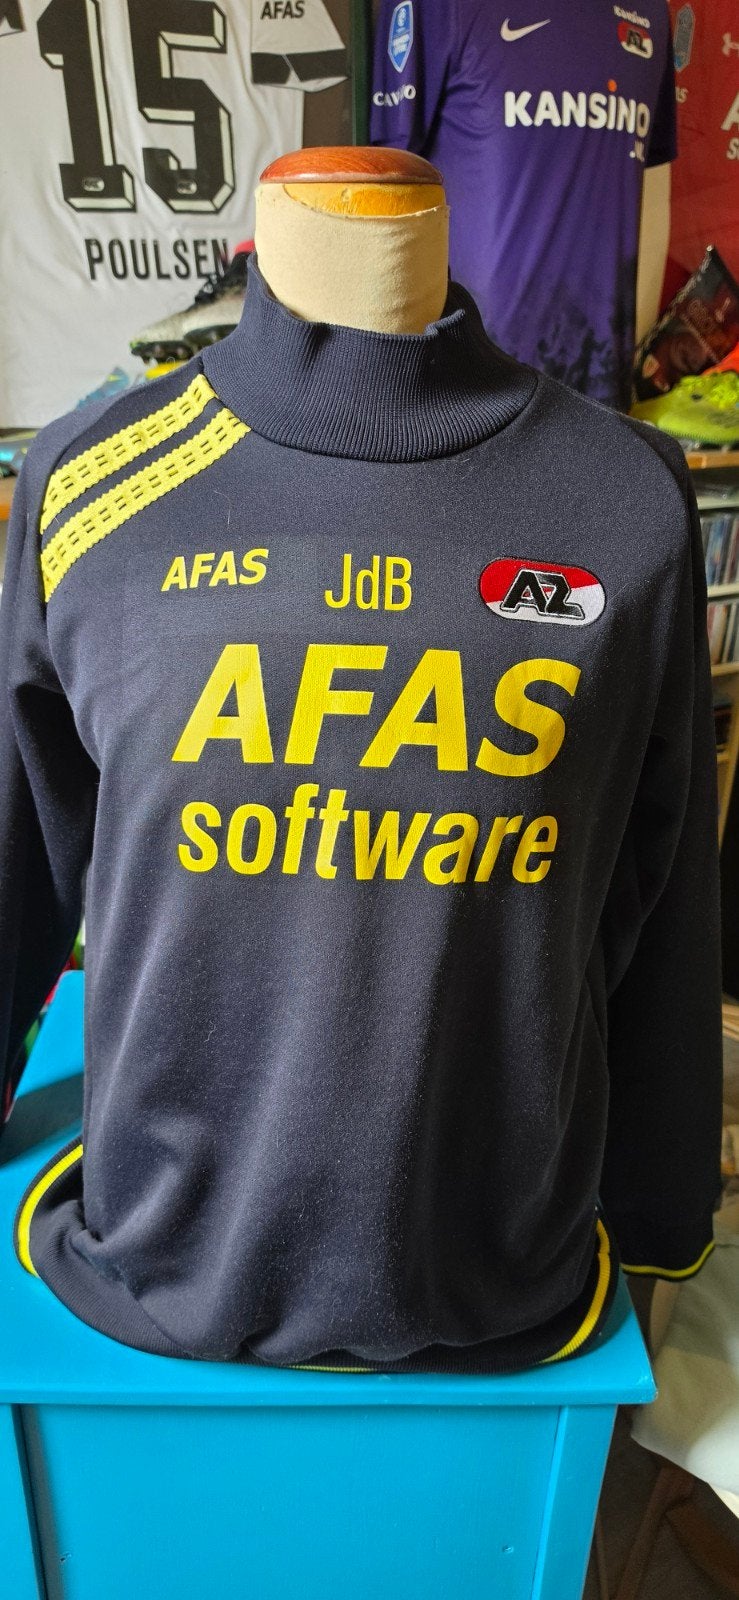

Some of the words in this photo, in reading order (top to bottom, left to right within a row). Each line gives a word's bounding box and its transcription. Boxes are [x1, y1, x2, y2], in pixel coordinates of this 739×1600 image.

[260, 0, 305, 19] AFAS
[37, 0, 236, 213] 15
[84, 238, 229, 280] POULSEN
[161, 548, 269, 592] AFAS
[325, 553, 412, 611] JdB
[171, 643, 582, 777] AFAS
[178, 783, 559, 884] software
